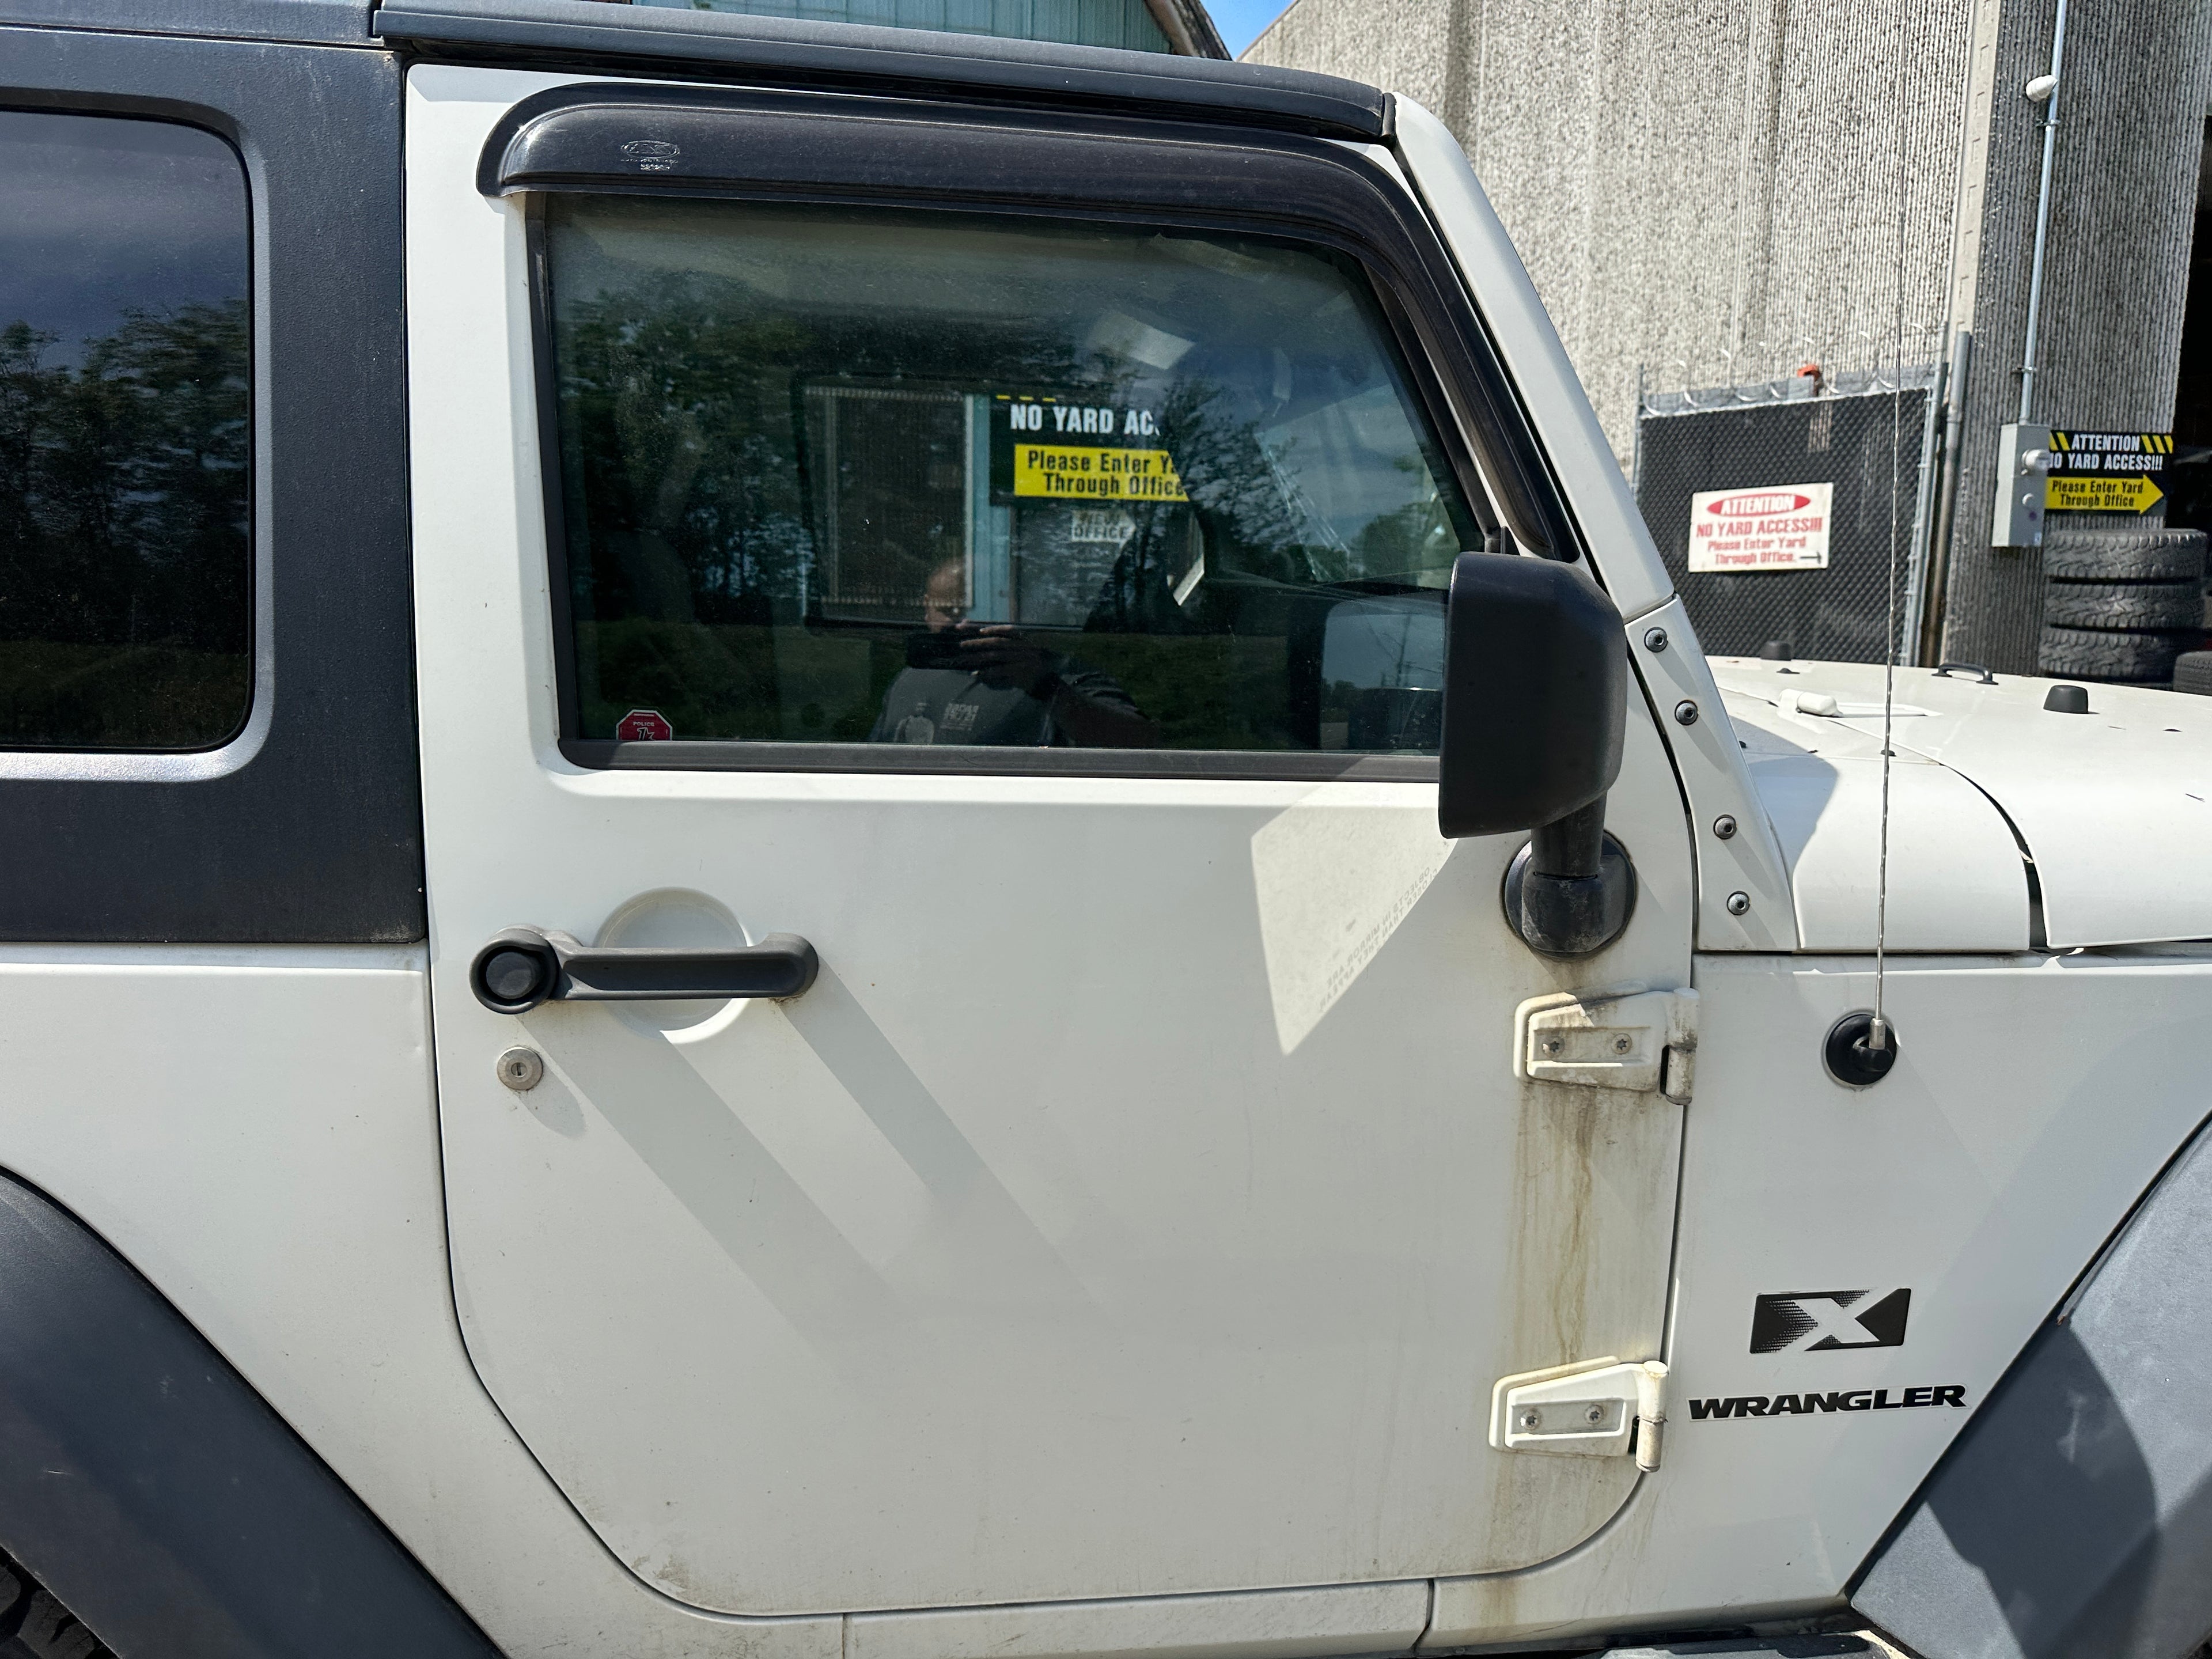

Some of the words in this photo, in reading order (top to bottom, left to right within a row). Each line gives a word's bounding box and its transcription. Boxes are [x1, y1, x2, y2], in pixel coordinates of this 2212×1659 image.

[1010, 403, 1043, 431] NO
[1052, 406, 1115, 433] YARD
[1124, 409, 1160, 436] AC
[2071, 433, 2141, 452] ATTENTION
[1028, 449, 1091, 470] Please
[1099, 452, 1152, 474] Enter
[2068, 453, 2100, 469] YARD
[2104, 454, 2163, 471] ACCESS!!!
[1043, 472, 1120, 497] Through
[2052, 479, 2086, 493] Please
[2090, 480, 2117, 493] Enter
[2122, 480, 2143, 494] Yard
[1719, 494, 1796, 516] ATTENTION
[2061, 494, 2100, 507] Through
[2104, 494, 2134, 507] Office
[1696, 524, 1713, 537] NO
[1718, 521, 1752, 536] YARD
[1708, 540, 1741, 551] Please
[1744, 538, 1774, 549] Enter
[1778, 536, 1806, 548] Yard
[1715, 552, 1756, 565] Through
[1689, 1384, 1968, 1421] WRANGLER
